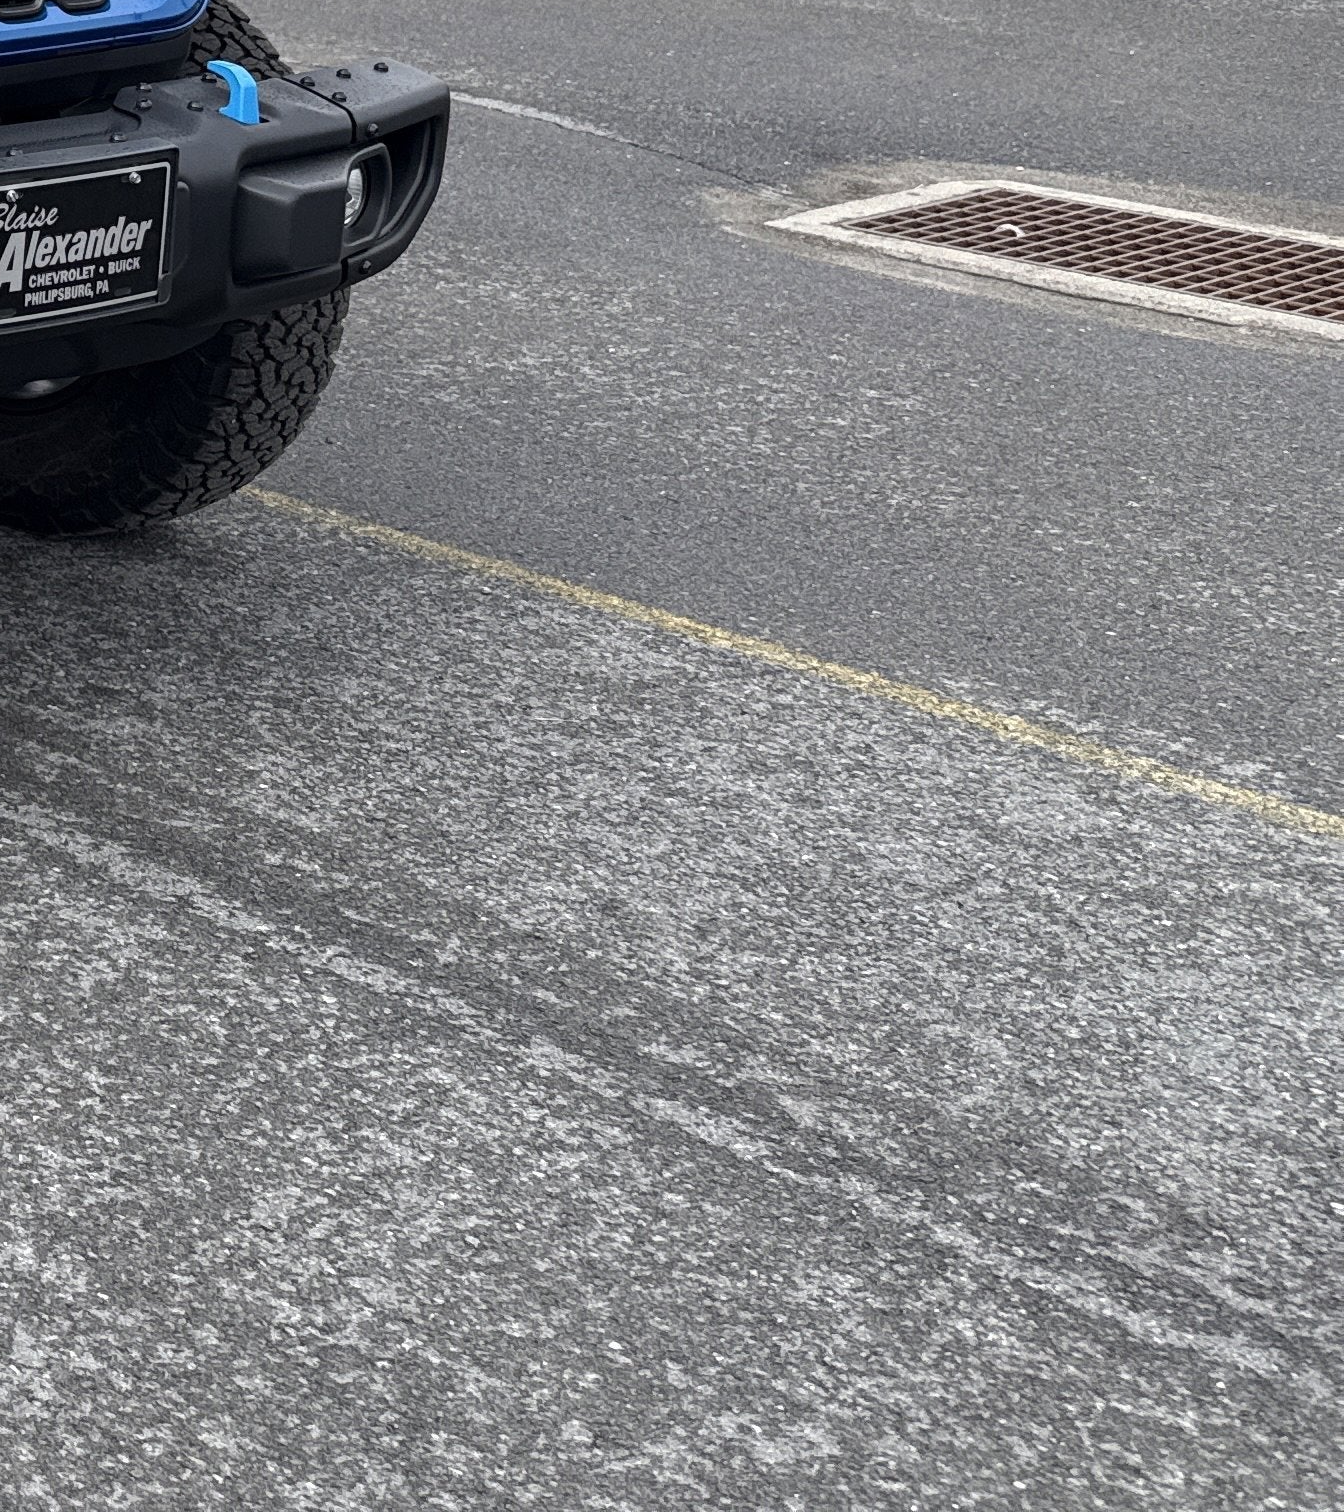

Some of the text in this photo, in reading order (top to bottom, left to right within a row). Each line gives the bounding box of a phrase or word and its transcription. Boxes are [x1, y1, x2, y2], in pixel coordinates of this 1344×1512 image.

[28, 256, 141, 289] CHEVROLET BUICK
[24, 280, 109, 307] PHILIPSBURG, PA
